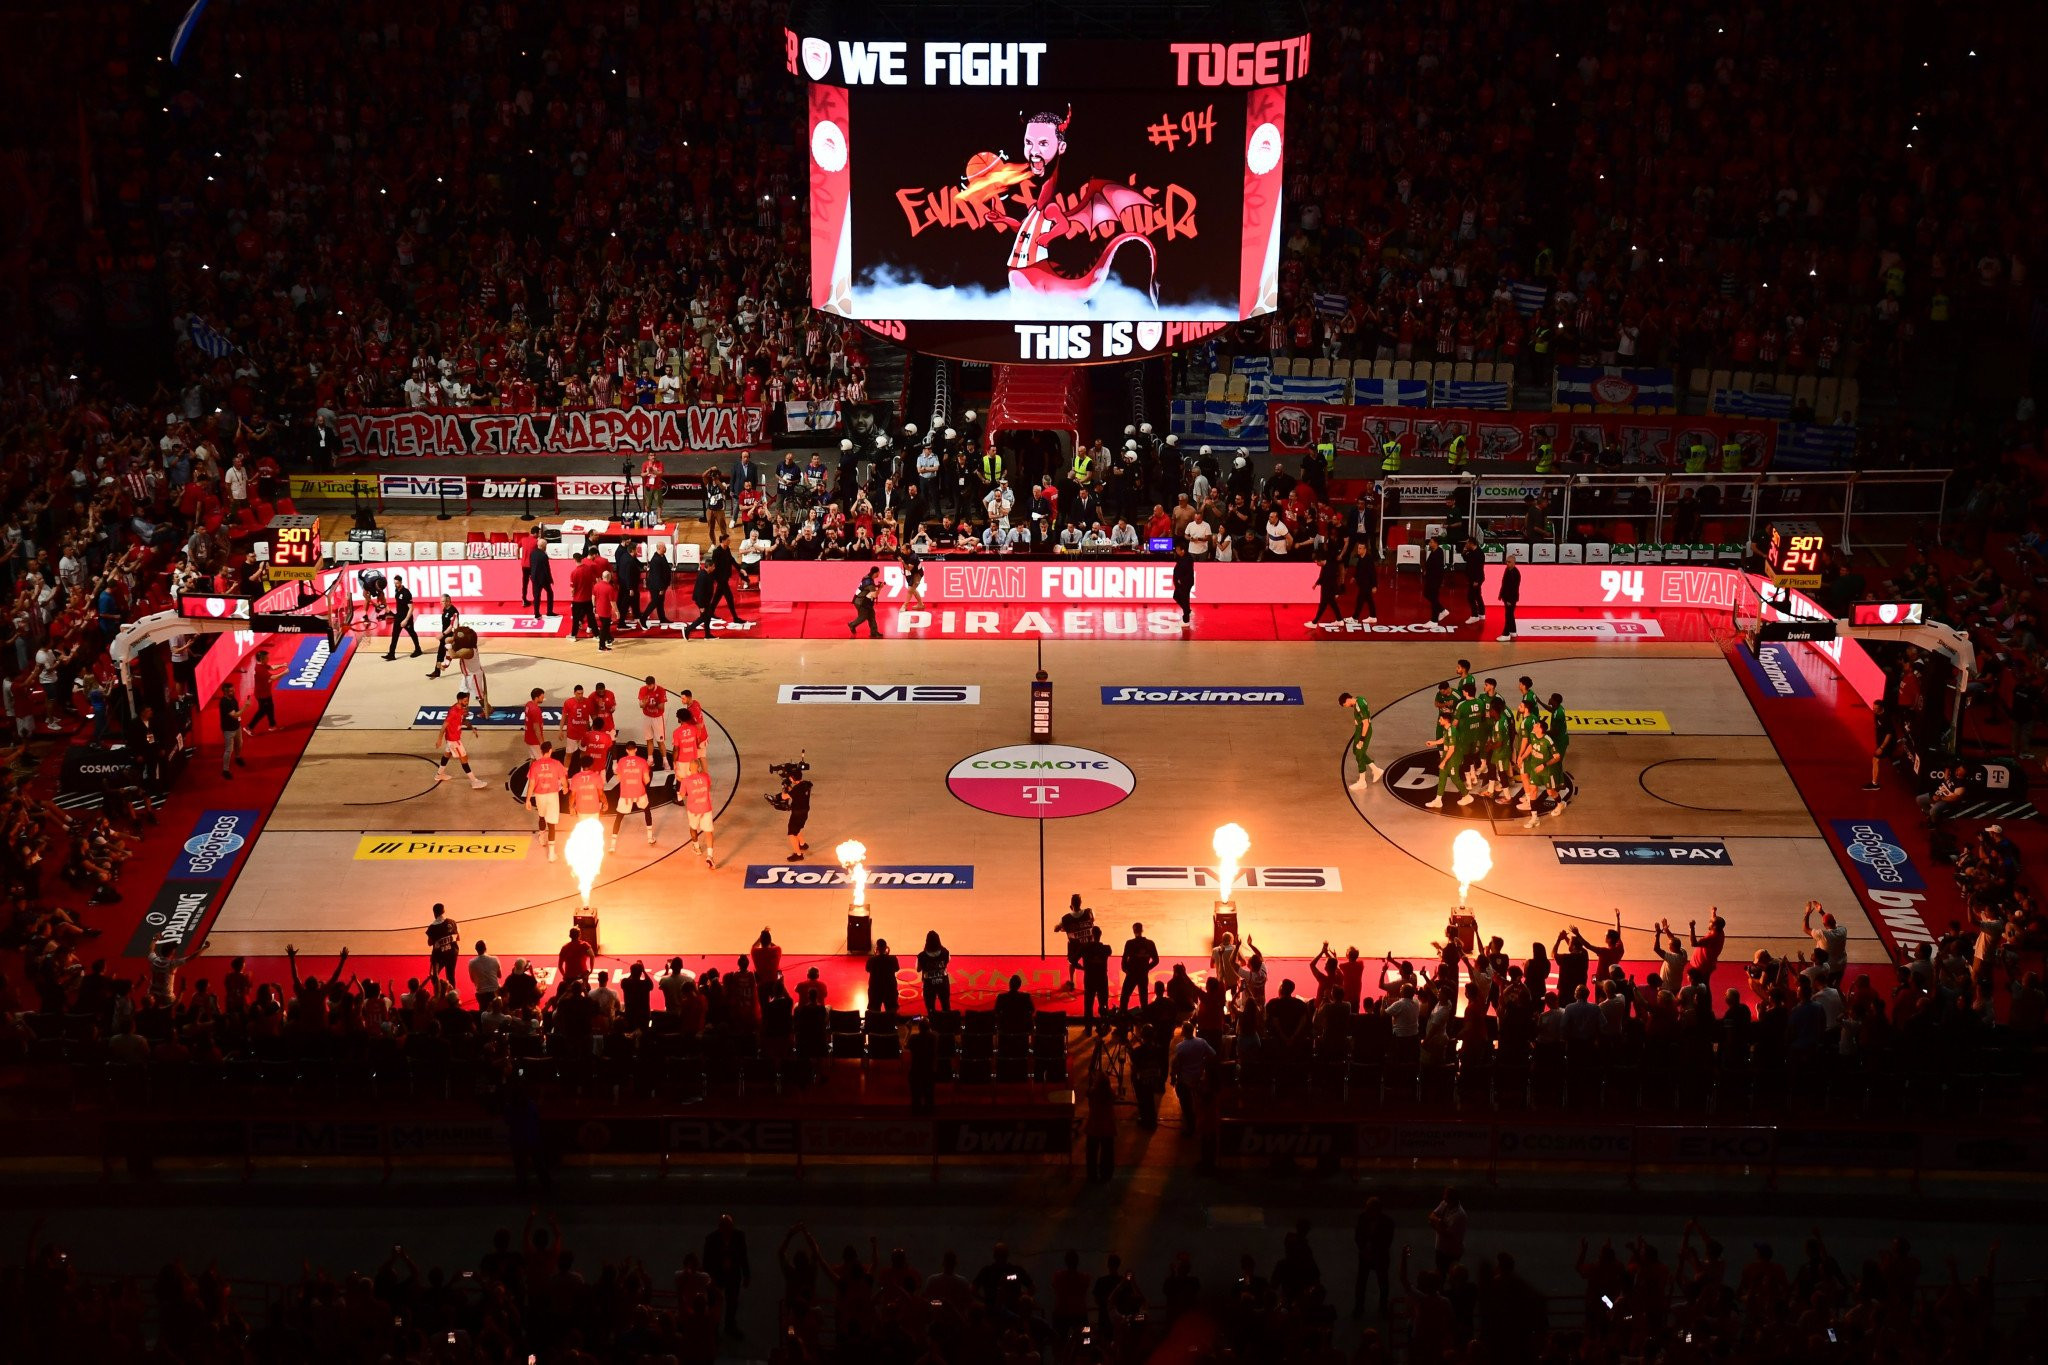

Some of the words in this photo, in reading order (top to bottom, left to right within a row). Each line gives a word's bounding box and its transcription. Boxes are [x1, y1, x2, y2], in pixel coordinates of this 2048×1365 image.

[838, 41, 907, 86] WE
[924, 41, 1047, 86] FIGHT
[1146, 104, 1217, 152] #94
[1013, 324, 1091, 360] THIS
[1103, 322, 1133, 358] IS
[471, 412, 541, 455] ΣΤΑ
[546, 404, 684, 452] ΑΔΕΡΦΙΑ
[482, 479, 541, 498] bwin
[275, 543, 307, 564] 24
[1790, 536, 1824, 551] 5:07
[1782, 551, 1817, 572] 24
[283, 570, 312, 578] Piraeus
[943, 567, 1026, 598] EVAN
[1042, 566, 1197, 599] FOURNIE
[1600, 570, 1645, 602] 94
[278, 624, 301, 633] bwin
[897, 611, 1190, 634] PIRAEUS
[1787, 631, 1811, 640] bwin
[790, 686, 967, 702] FMS
[1112, 687, 1286, 702] Stoiximan
[971, 760, 1109, 770] COSMOTE
[406, 840, 517, 854] Piraeus
[1557, 847, 1621, 859] NBG
[1669, 847, 1726, 860] PAY
[955, 1123, 1047, 1153] bwin
